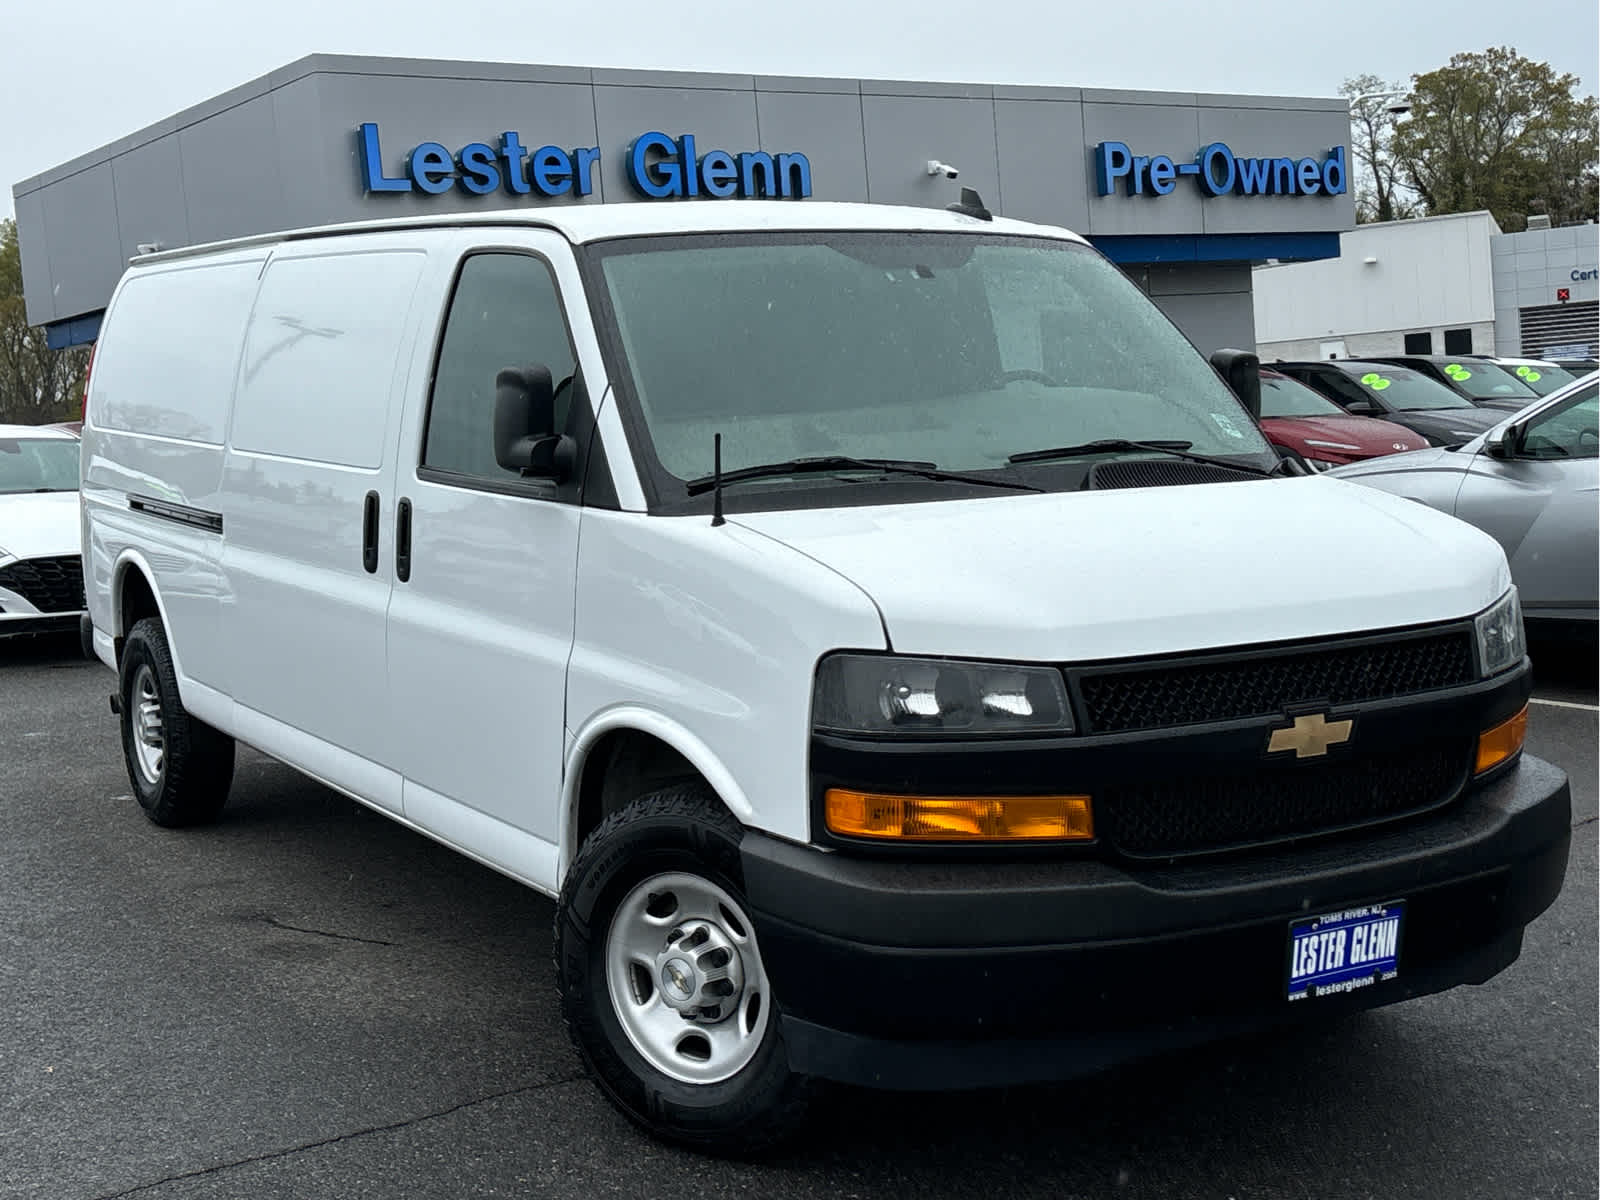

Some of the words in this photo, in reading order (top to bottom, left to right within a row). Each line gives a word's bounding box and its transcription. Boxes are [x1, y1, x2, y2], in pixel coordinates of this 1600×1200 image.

[359, 123, 599, 196] Lester
[628, 131, 812, 199] Glenn
[1097, 142, 1347, 196] Pre-Owned
[1570, 269, 1599, 281] Cert
[1292, 930, 1347, 978] LESTER
[1350, 919, 1399, 964] GLENN
[1316, 976, 1374, 996] lesterglenn
